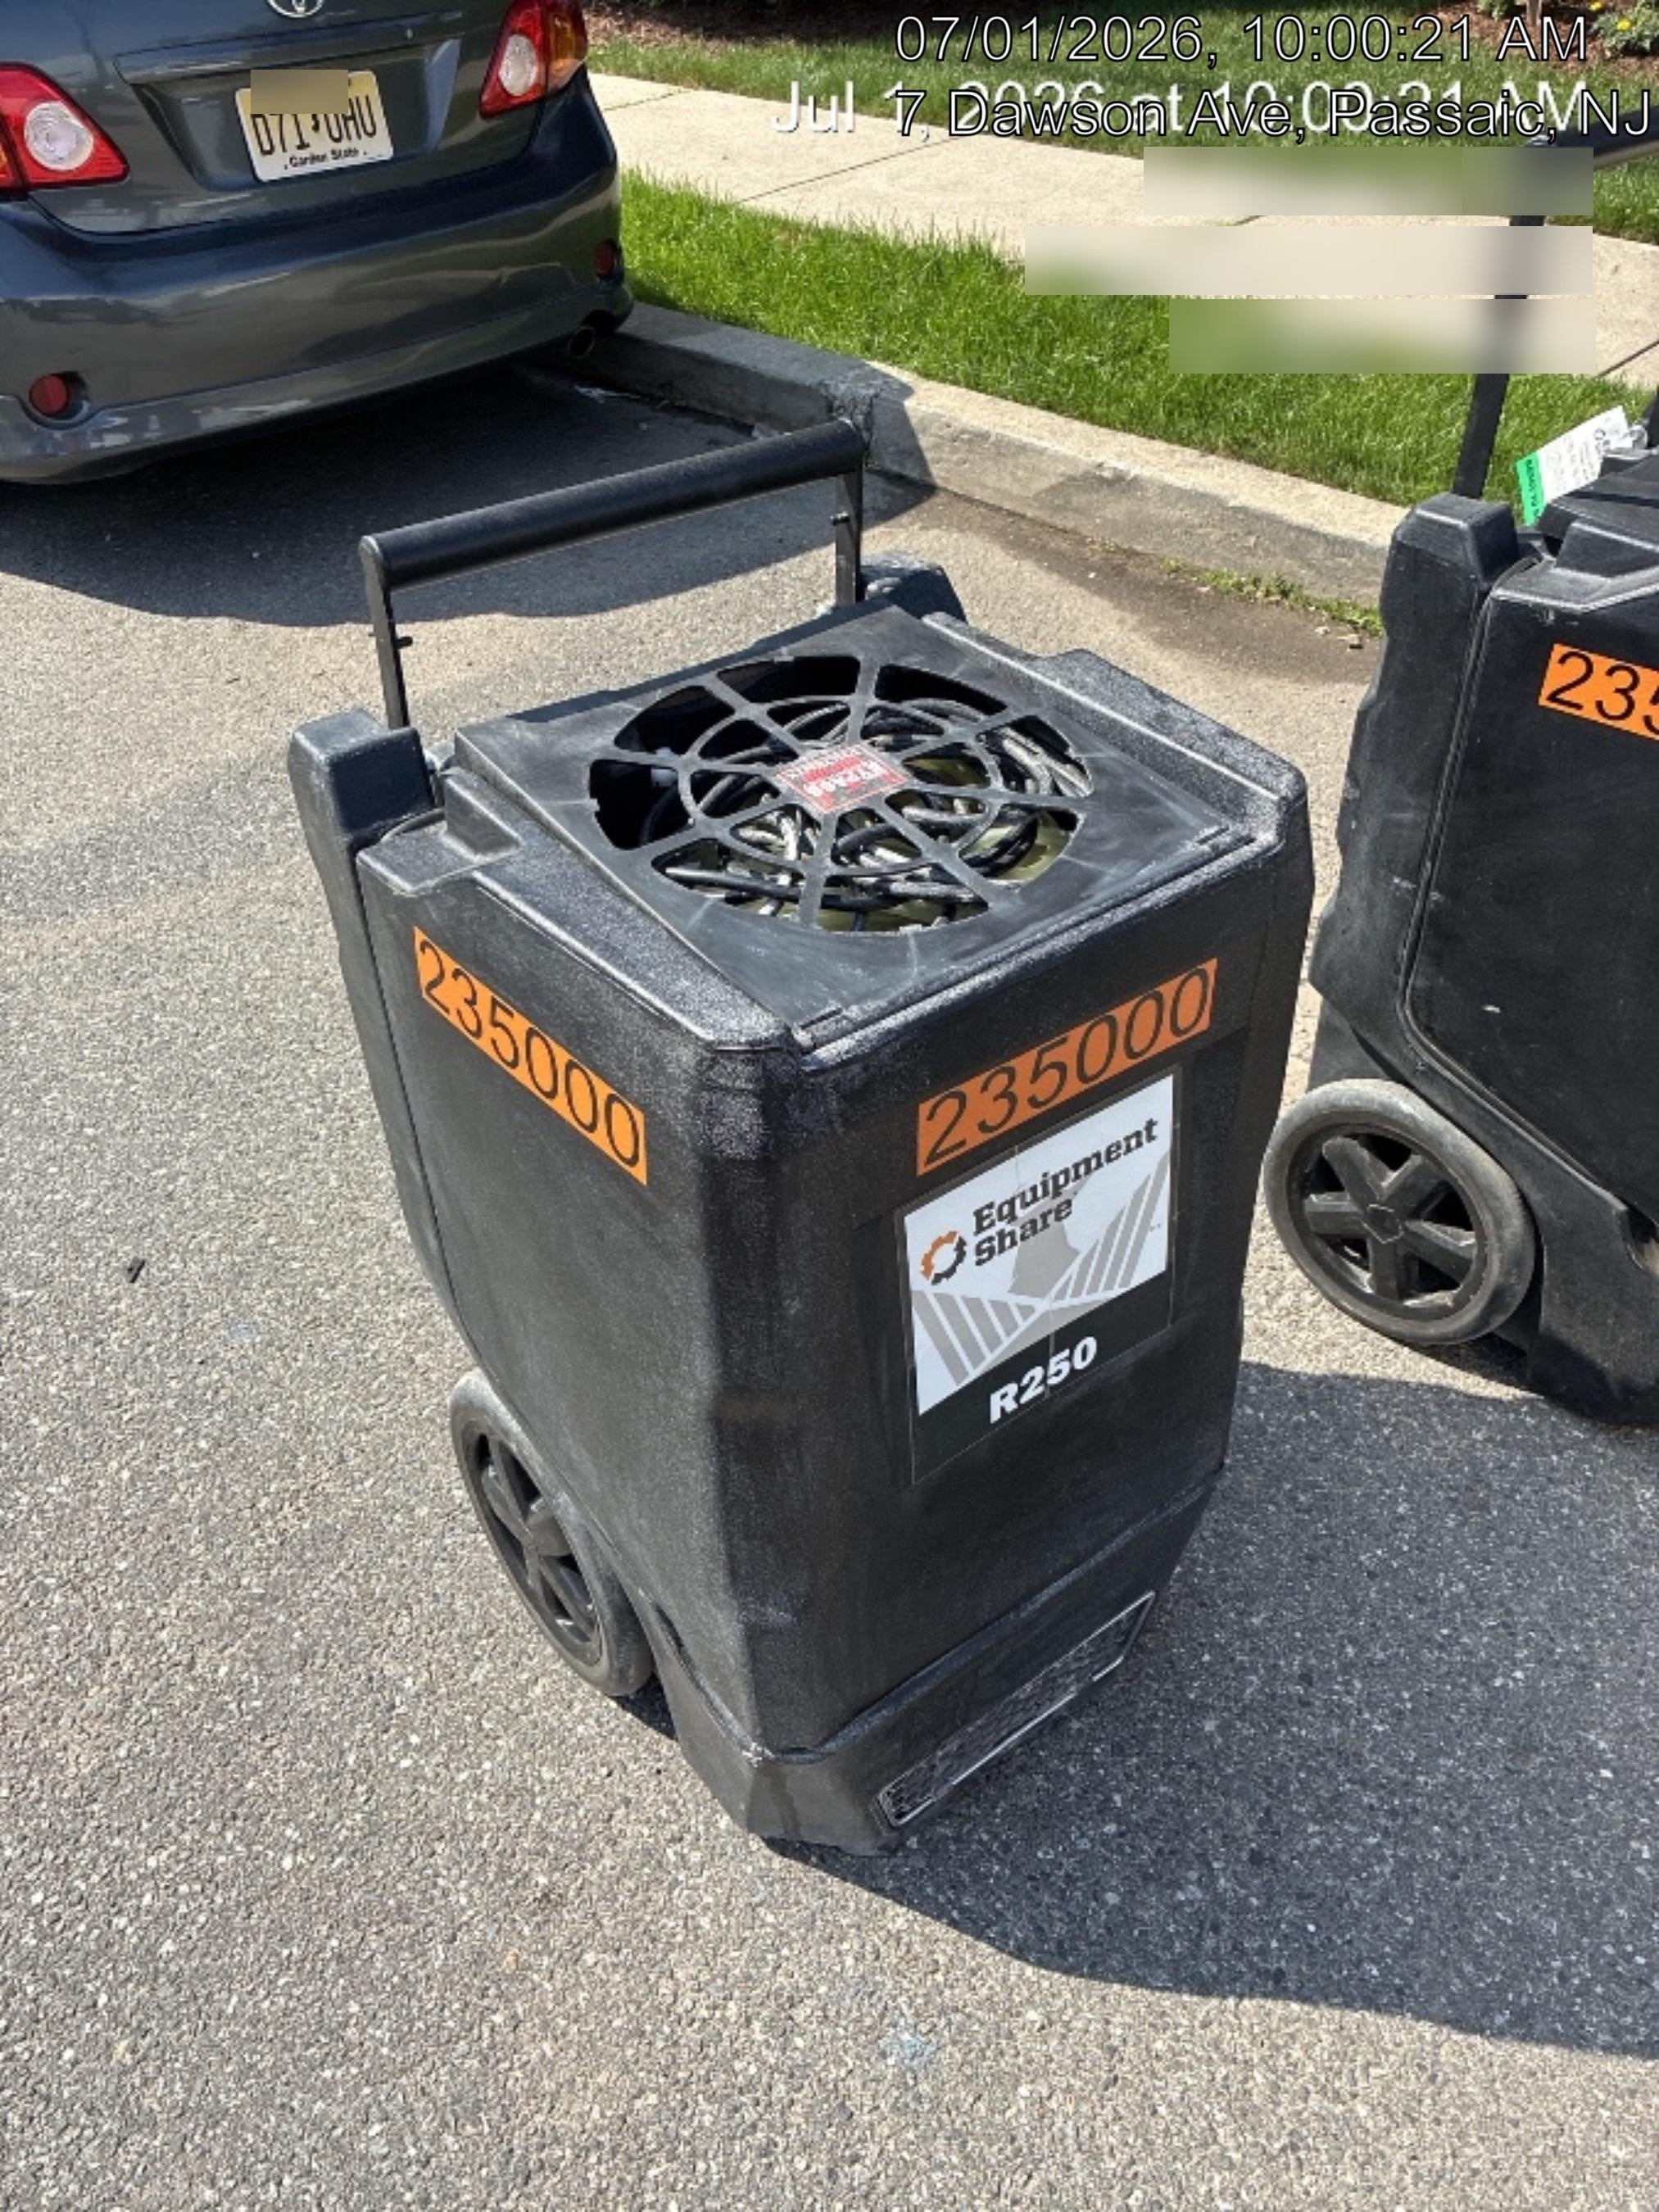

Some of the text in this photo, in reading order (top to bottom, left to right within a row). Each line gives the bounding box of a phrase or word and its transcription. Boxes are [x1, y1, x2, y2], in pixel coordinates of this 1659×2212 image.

[419, 939, 641, 1168] 235000
[923, 967, 1209, 1167] 235000
[972, 1117, 1158, 1236] Equipment
[975, 1198, 1073, 1267] Share
[990, 1335, 1099, 1424] R250
